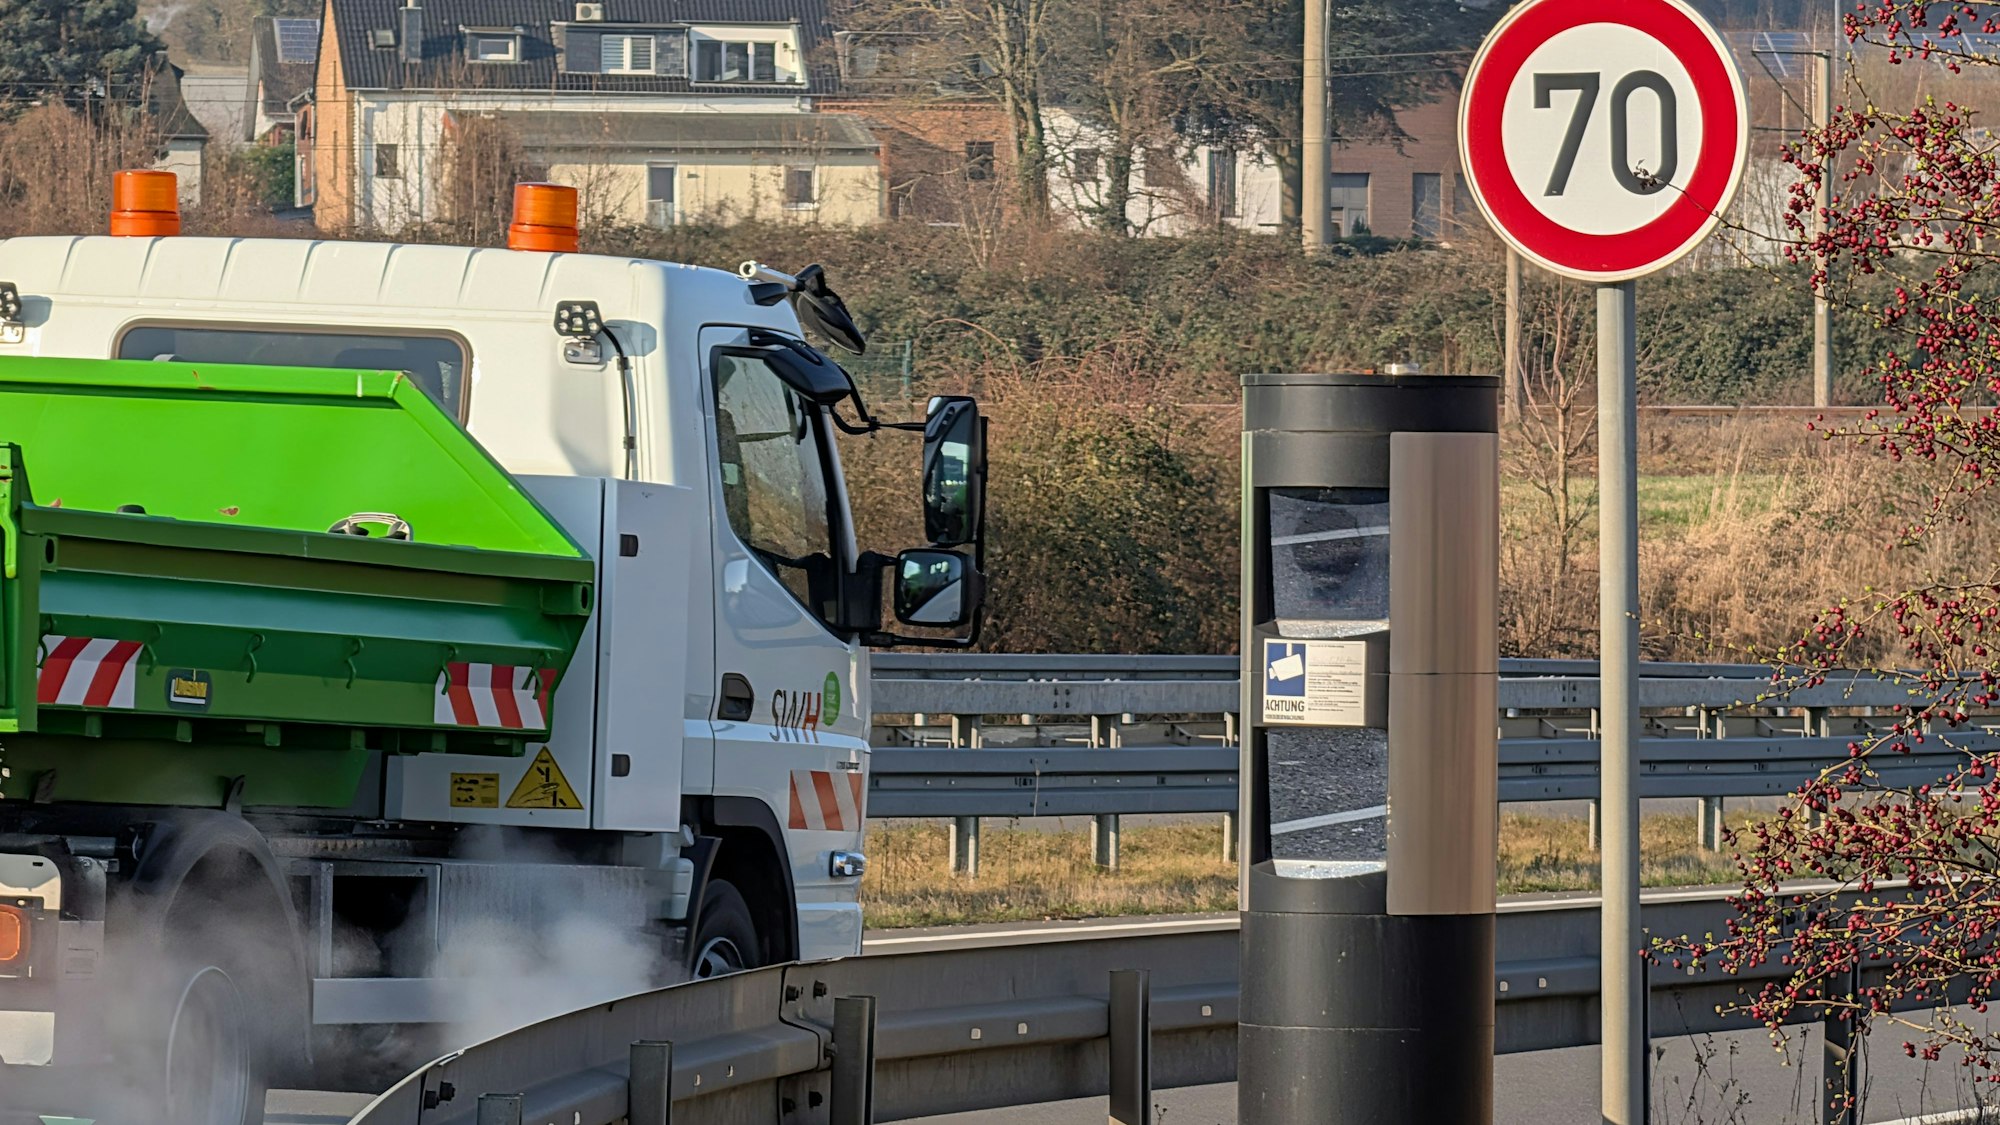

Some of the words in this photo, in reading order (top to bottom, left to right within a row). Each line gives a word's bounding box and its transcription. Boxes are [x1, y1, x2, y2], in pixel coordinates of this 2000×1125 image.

[1533, 70, 1677, 196] 70
[769, 689, 821, 744] SWH
[1265, 699, 1305, 712] ACHTUNG
